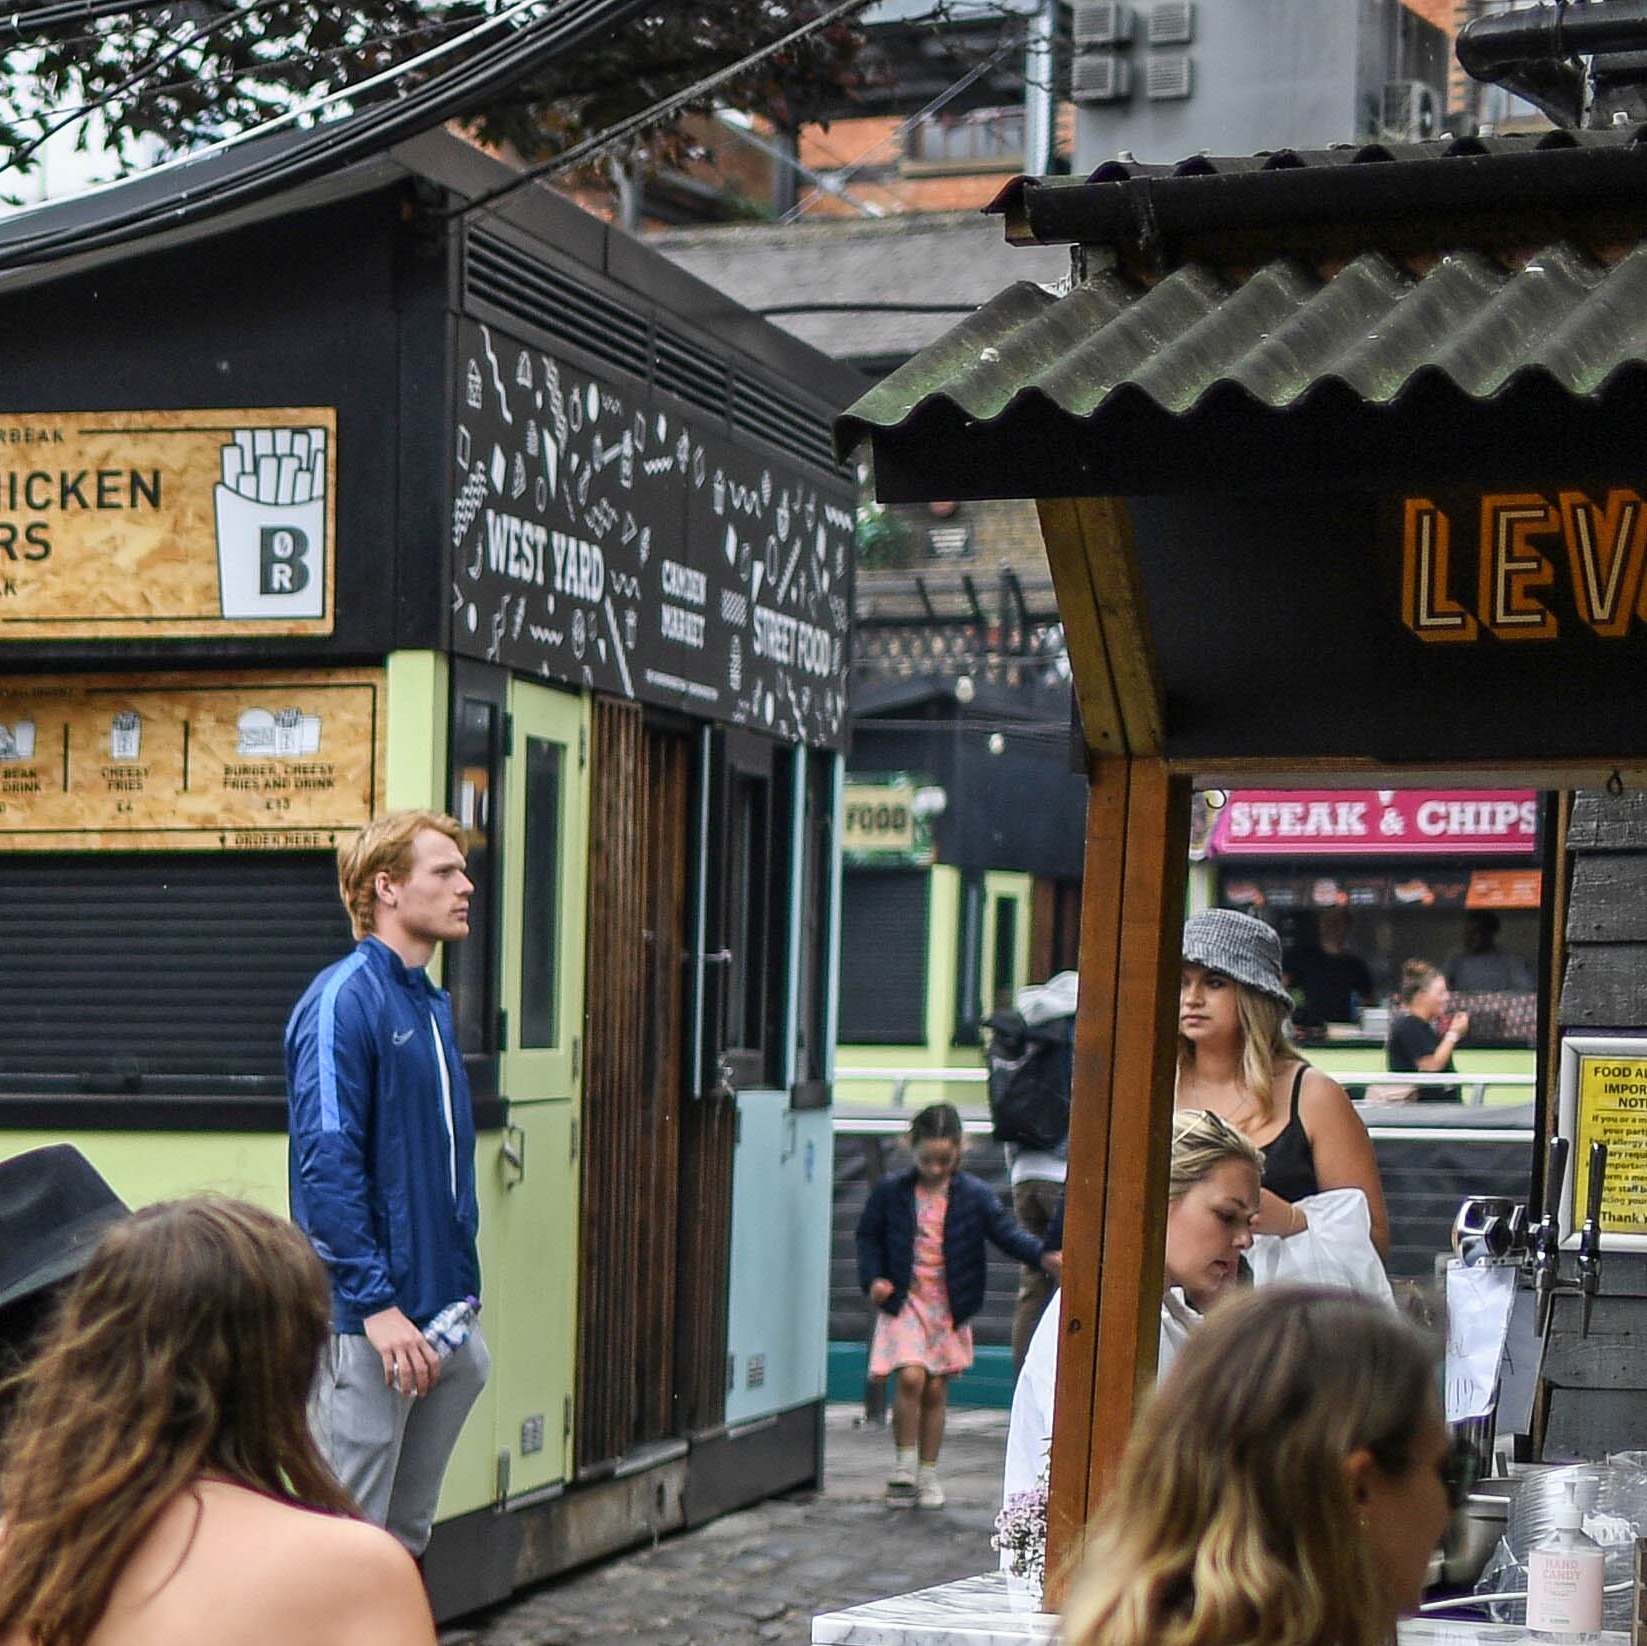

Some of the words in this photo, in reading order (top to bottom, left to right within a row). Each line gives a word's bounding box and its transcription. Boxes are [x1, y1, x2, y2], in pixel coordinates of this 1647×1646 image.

[487, 508, 548, 586] WEST
[552, 530, 605, 603] YARD
[1401, 489, 1647, 642] LEV
[753, 605, 798, 667] STREET
[798, 620, 832, 678] FOOD
[845, 803, 908, 834] FOOD
[1229, 801, 1368, 838] STEAK
[1378, 807, 1405, 837] &
[1416, 799, 1536, 836] CHIPS
[1594, 1066, 1632, 1078] FOOD
[1618, 1097, 1647, 1108] NOT
[1601, 1210, 1639, 1223] Thank
